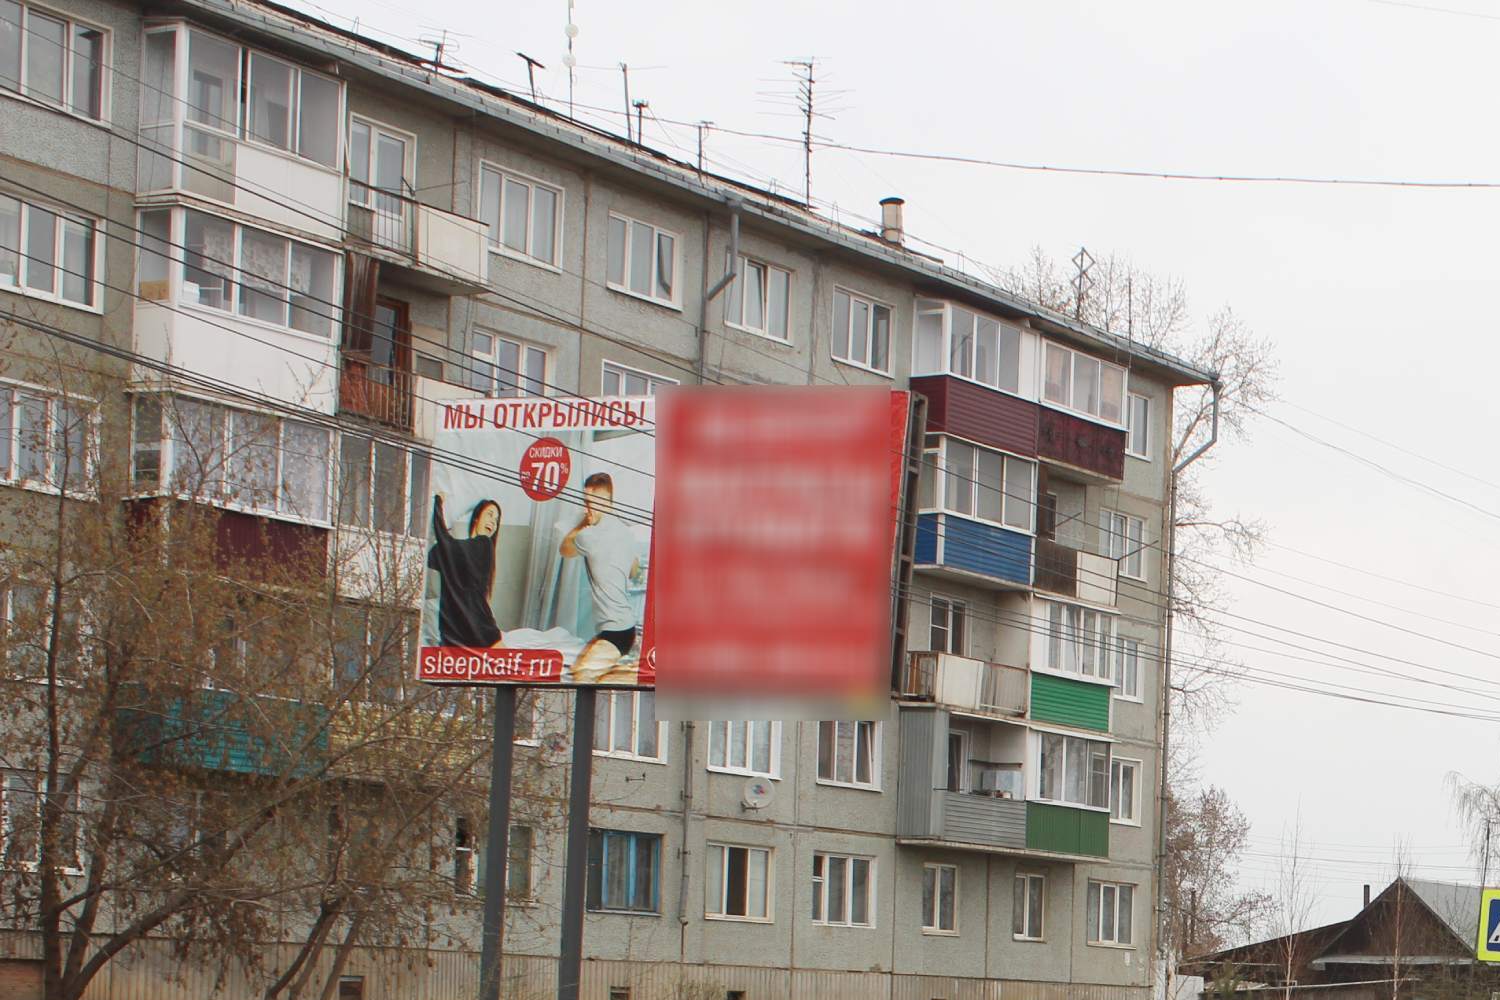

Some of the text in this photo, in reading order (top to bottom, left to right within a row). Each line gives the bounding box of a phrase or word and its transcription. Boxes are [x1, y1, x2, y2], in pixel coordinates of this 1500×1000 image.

[443, 400, 646, 430] МЫ ОТКРЫЛИСЬ!
[529, 446, 563, 459] СКИДКИ
[424, 651, 553, 681] sleepkaif.ru
